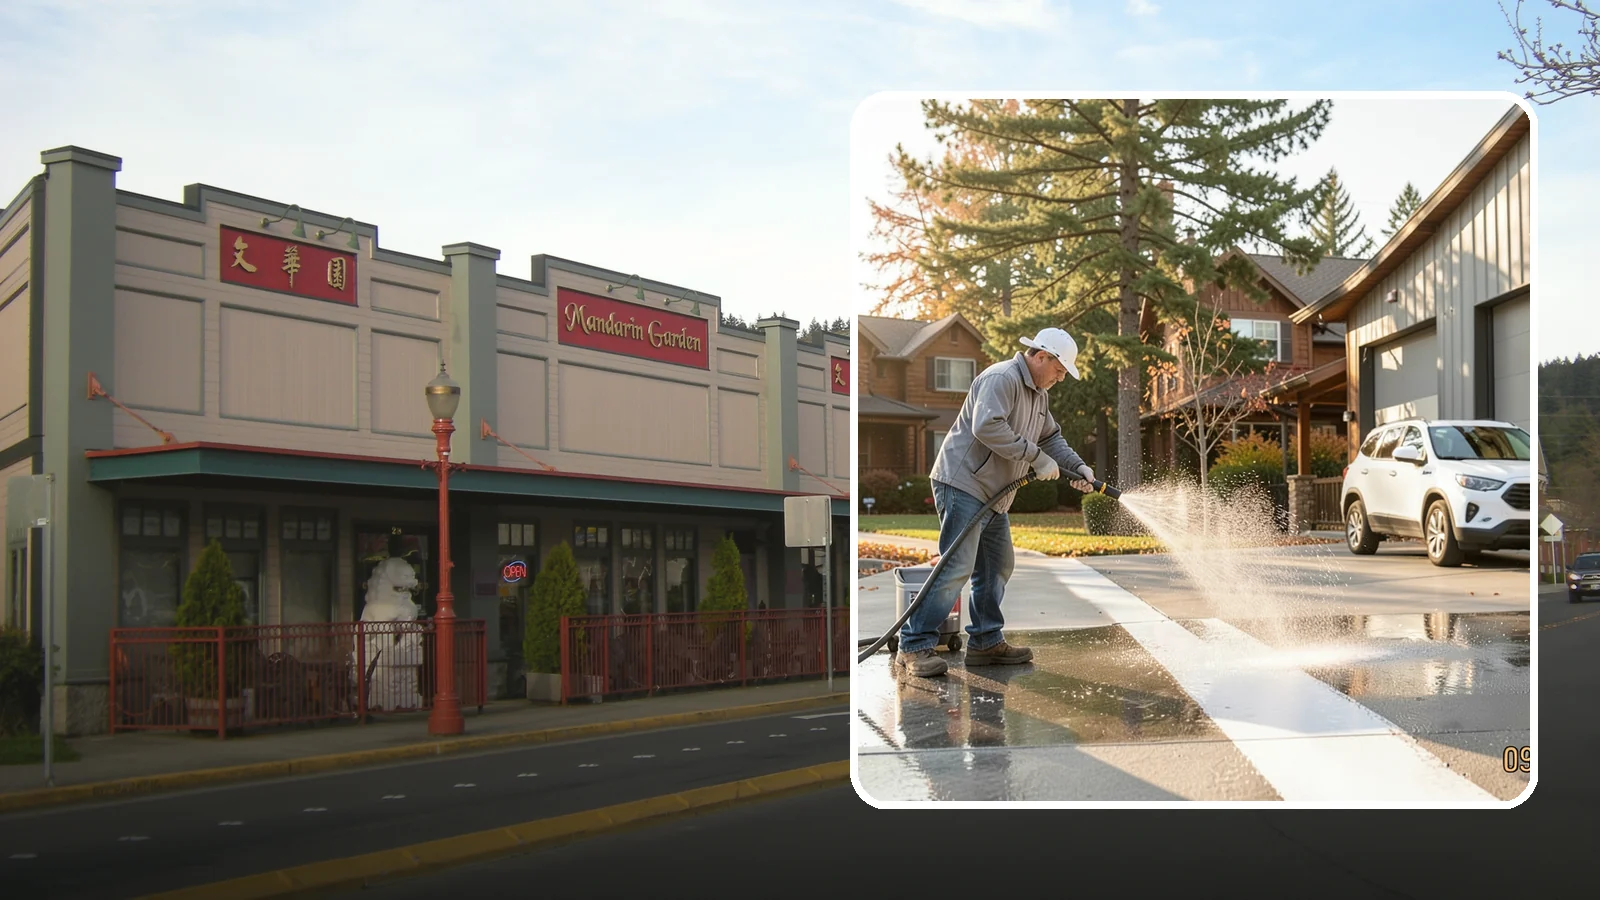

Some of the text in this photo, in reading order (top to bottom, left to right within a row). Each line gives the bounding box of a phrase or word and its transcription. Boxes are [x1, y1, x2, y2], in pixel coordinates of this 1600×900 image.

[231, 235, 346, 290] 文華園
[564, 302, 702, 352] Mandarin Garden
[835, 363, 846, 386] 文
[503, 565, 527, 578] OPEN
